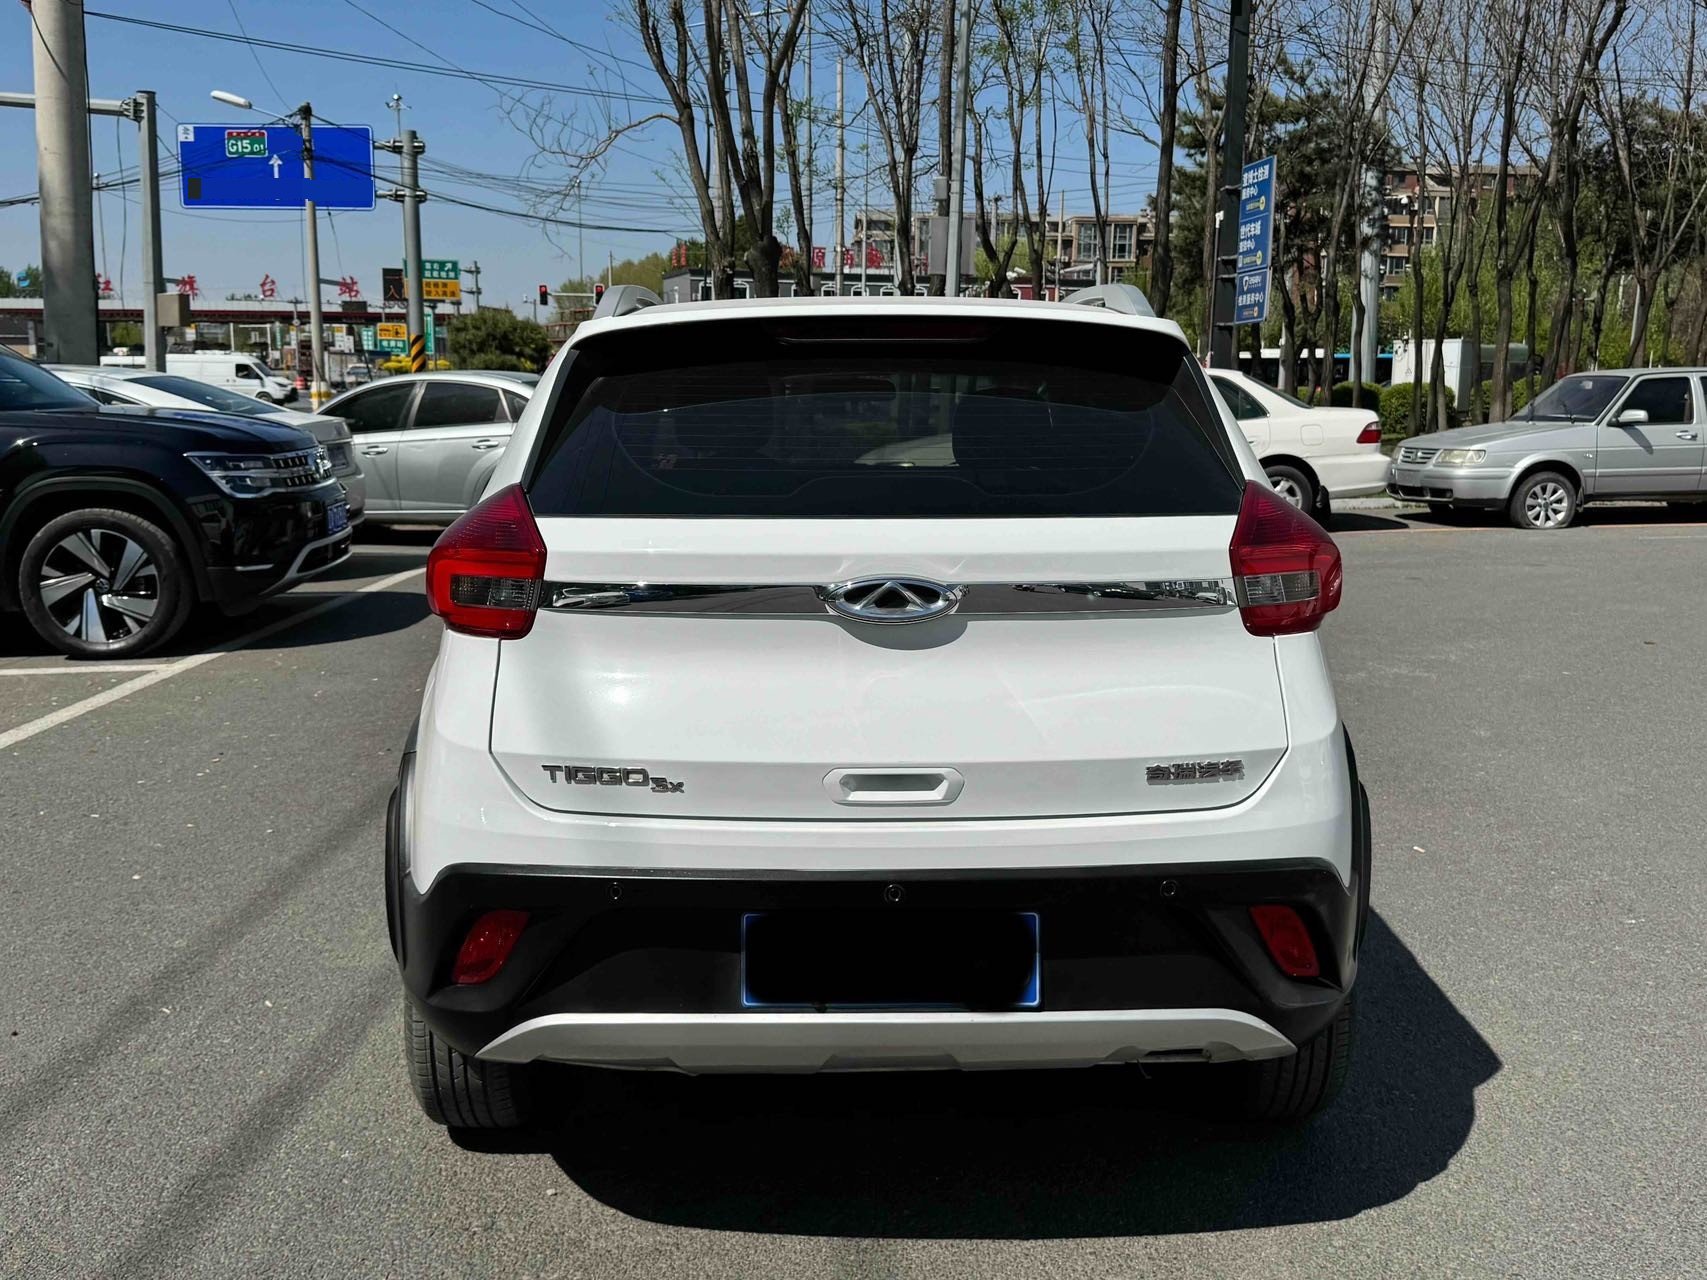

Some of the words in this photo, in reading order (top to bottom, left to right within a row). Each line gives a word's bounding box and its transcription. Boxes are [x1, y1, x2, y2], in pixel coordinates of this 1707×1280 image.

[541, 764, 650, 787] TIGGO
[1145, 759, 1245, 782] 奇瑞汽车
